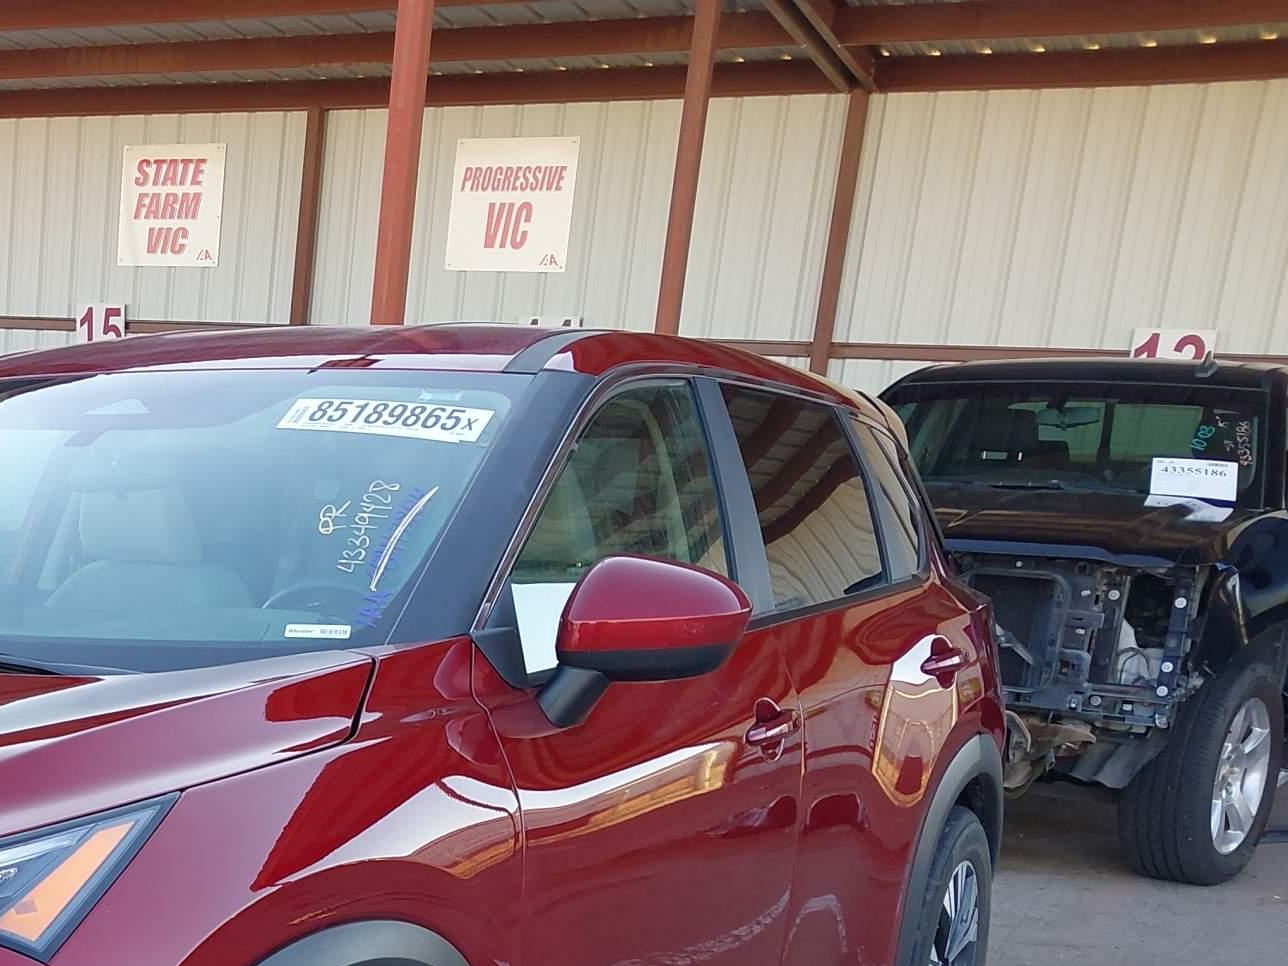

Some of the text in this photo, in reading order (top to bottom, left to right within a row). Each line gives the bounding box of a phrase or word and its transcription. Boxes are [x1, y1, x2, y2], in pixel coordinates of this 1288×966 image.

[134, 158, 208, 188] STATE
[460, 165, 568, 192] PROGRESSIVE
[133, 192, 203, 221] FARM
[483, 201, 533, 250] VIC
[146, 226, 190, 255] VIC
[79, 307, 123, 342] 15
[1160, 465, 1227, 478] 43355186
[336, 479, 400, 573] 43349428
